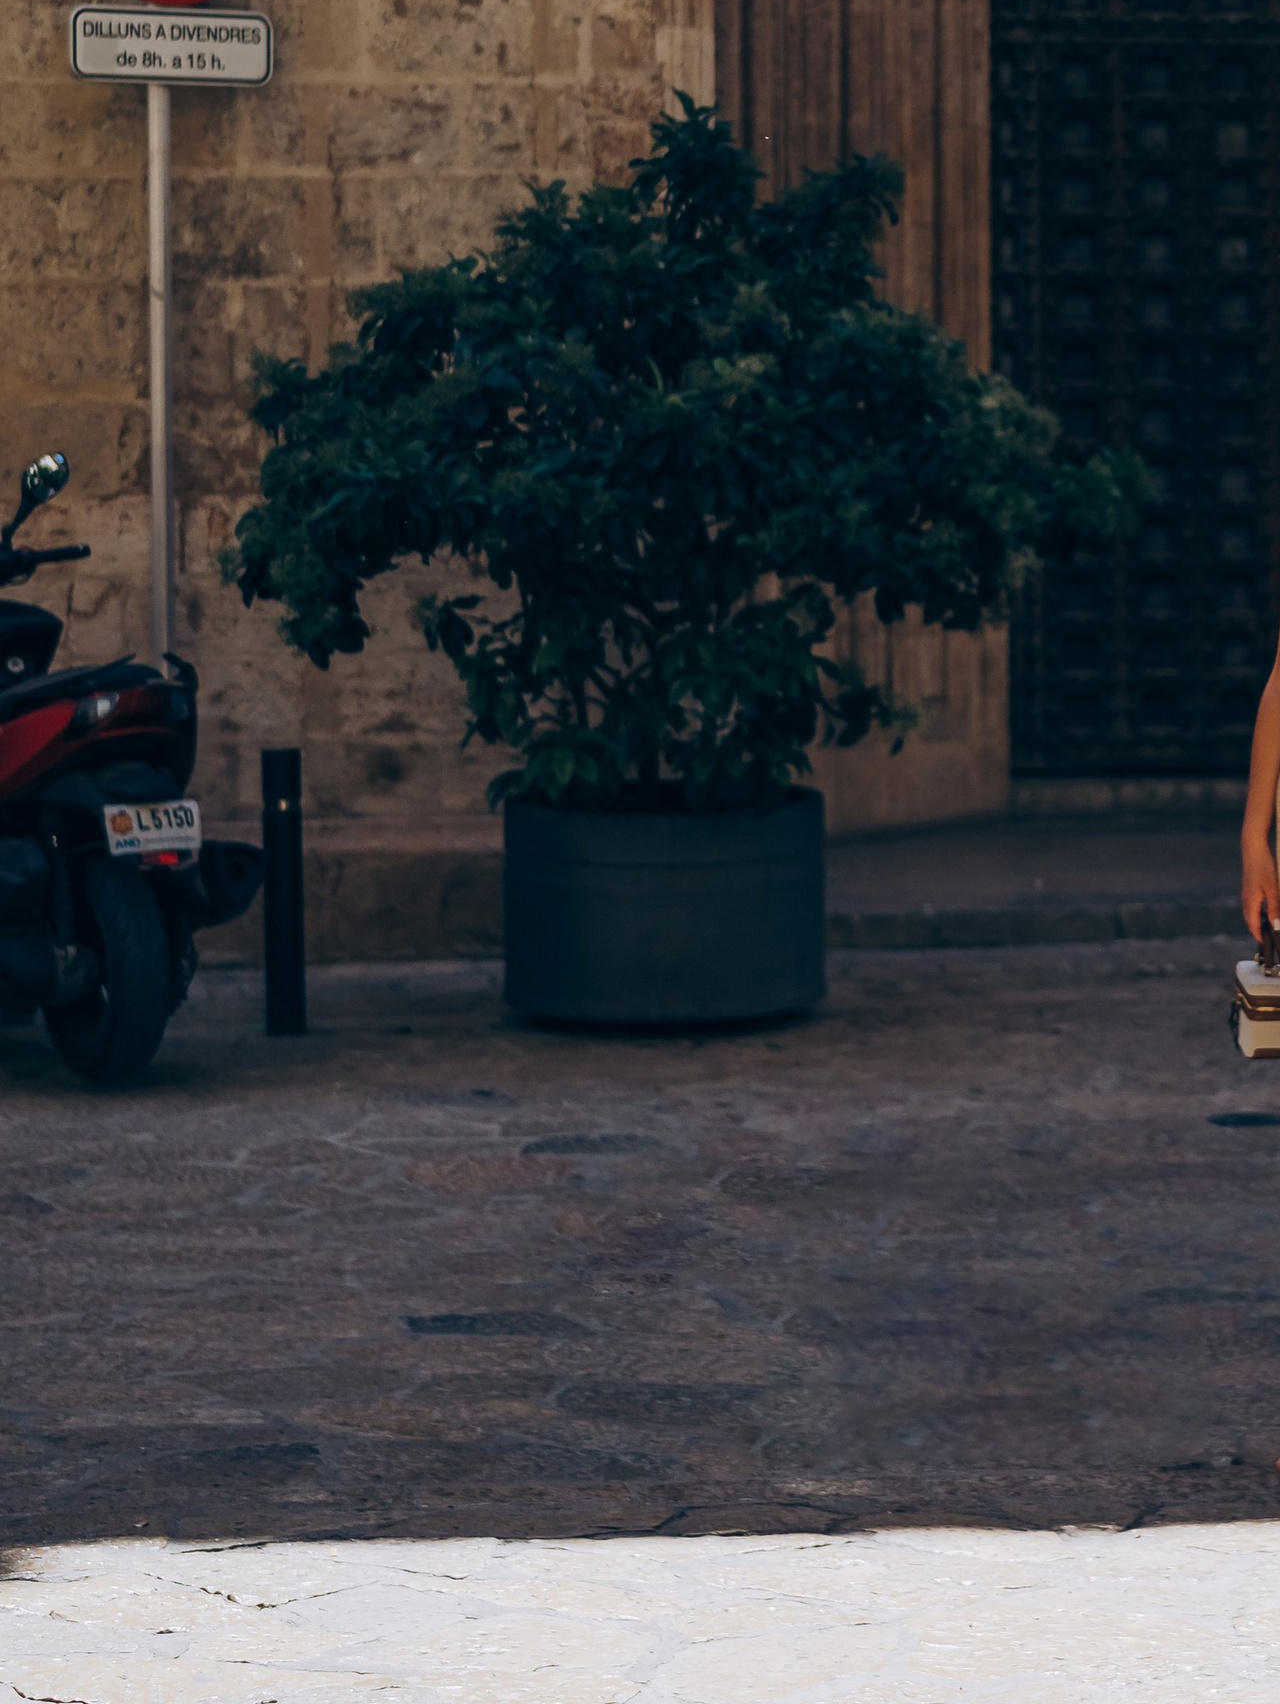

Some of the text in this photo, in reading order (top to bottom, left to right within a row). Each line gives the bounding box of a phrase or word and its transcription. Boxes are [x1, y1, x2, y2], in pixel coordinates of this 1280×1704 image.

[83, 21, 262, 44] DILLUNS A DIVENDRES
[116, 50, 138, 68] de
[172, 56, 183, 69] a
[187, 54, 207, 71] 15
